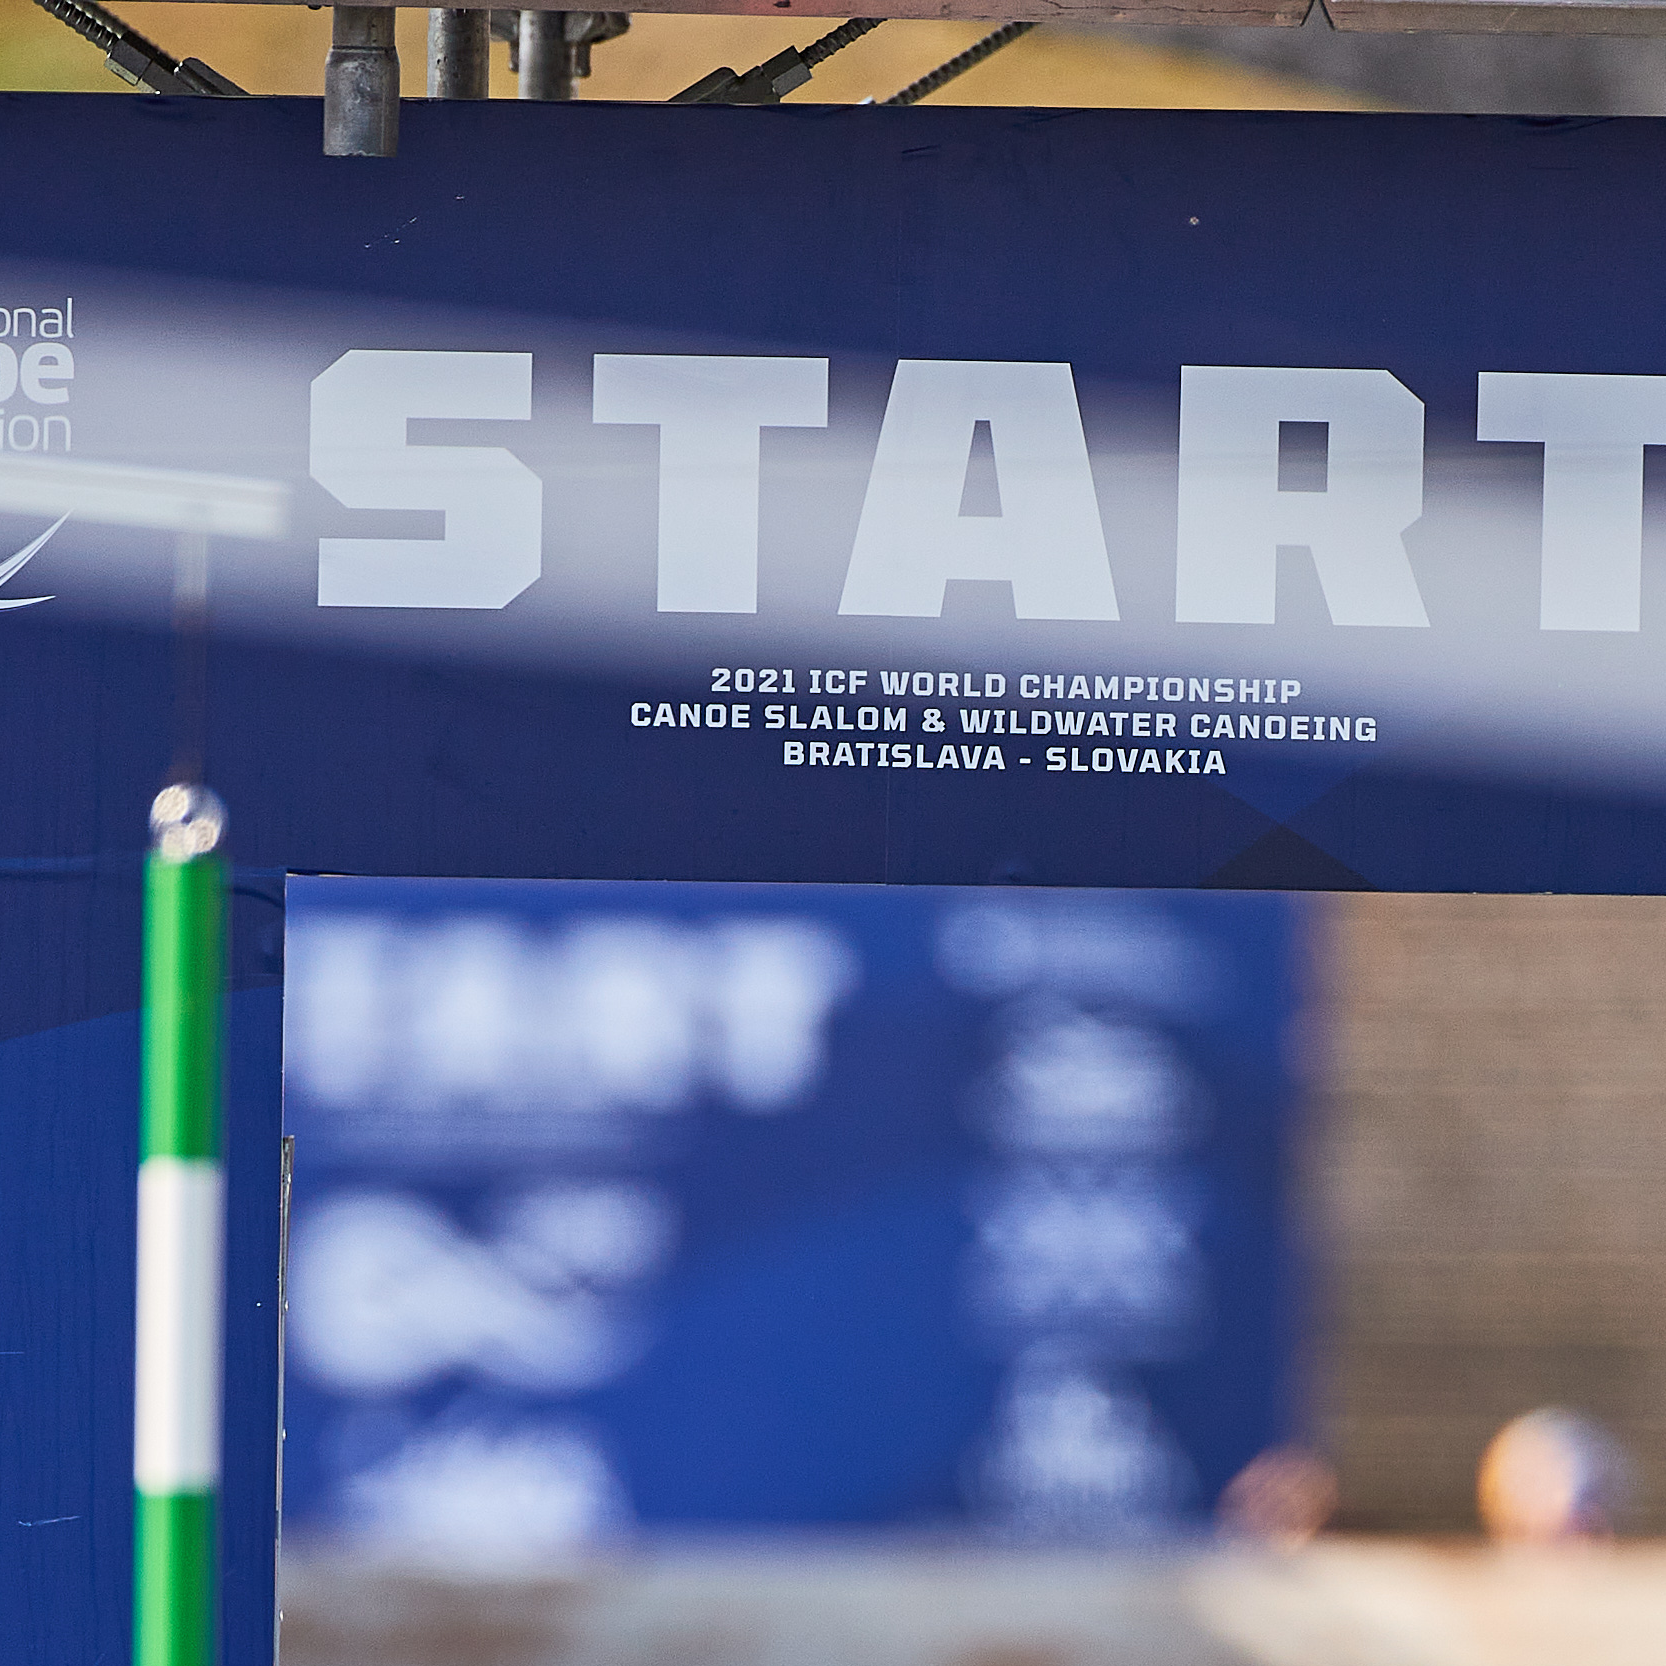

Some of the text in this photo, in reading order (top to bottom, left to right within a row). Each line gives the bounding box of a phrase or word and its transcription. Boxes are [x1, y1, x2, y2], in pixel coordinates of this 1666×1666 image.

[711, 667, 1303, 705] 2021 ICF WORLD CHAMPIONSHIP
[630, 702, 1377, 742] CANOE SLALOM & WILDWATER CANOEING
[783, 741, 1006, 770] BRATISLAVA
[1046, 746, 1226, 775] SLOVAKIA
